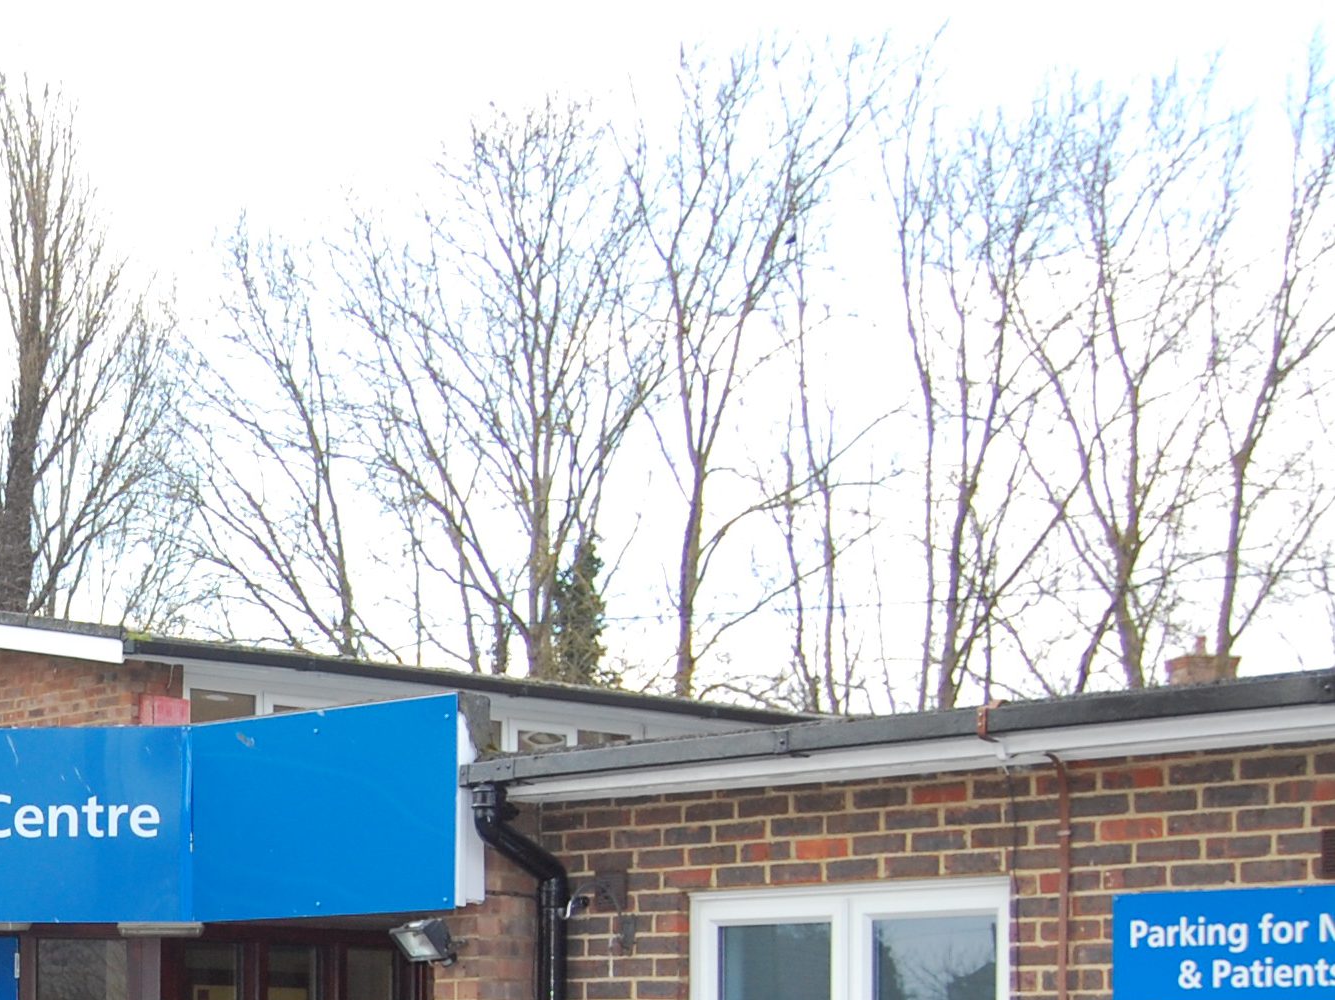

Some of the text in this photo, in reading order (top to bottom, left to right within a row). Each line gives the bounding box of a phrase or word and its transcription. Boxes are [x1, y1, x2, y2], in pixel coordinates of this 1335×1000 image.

[1129, 915, 1250, 954] Parking
[1258, 912, 1310, 945] for
[1177, 959, 1204, 990] &
